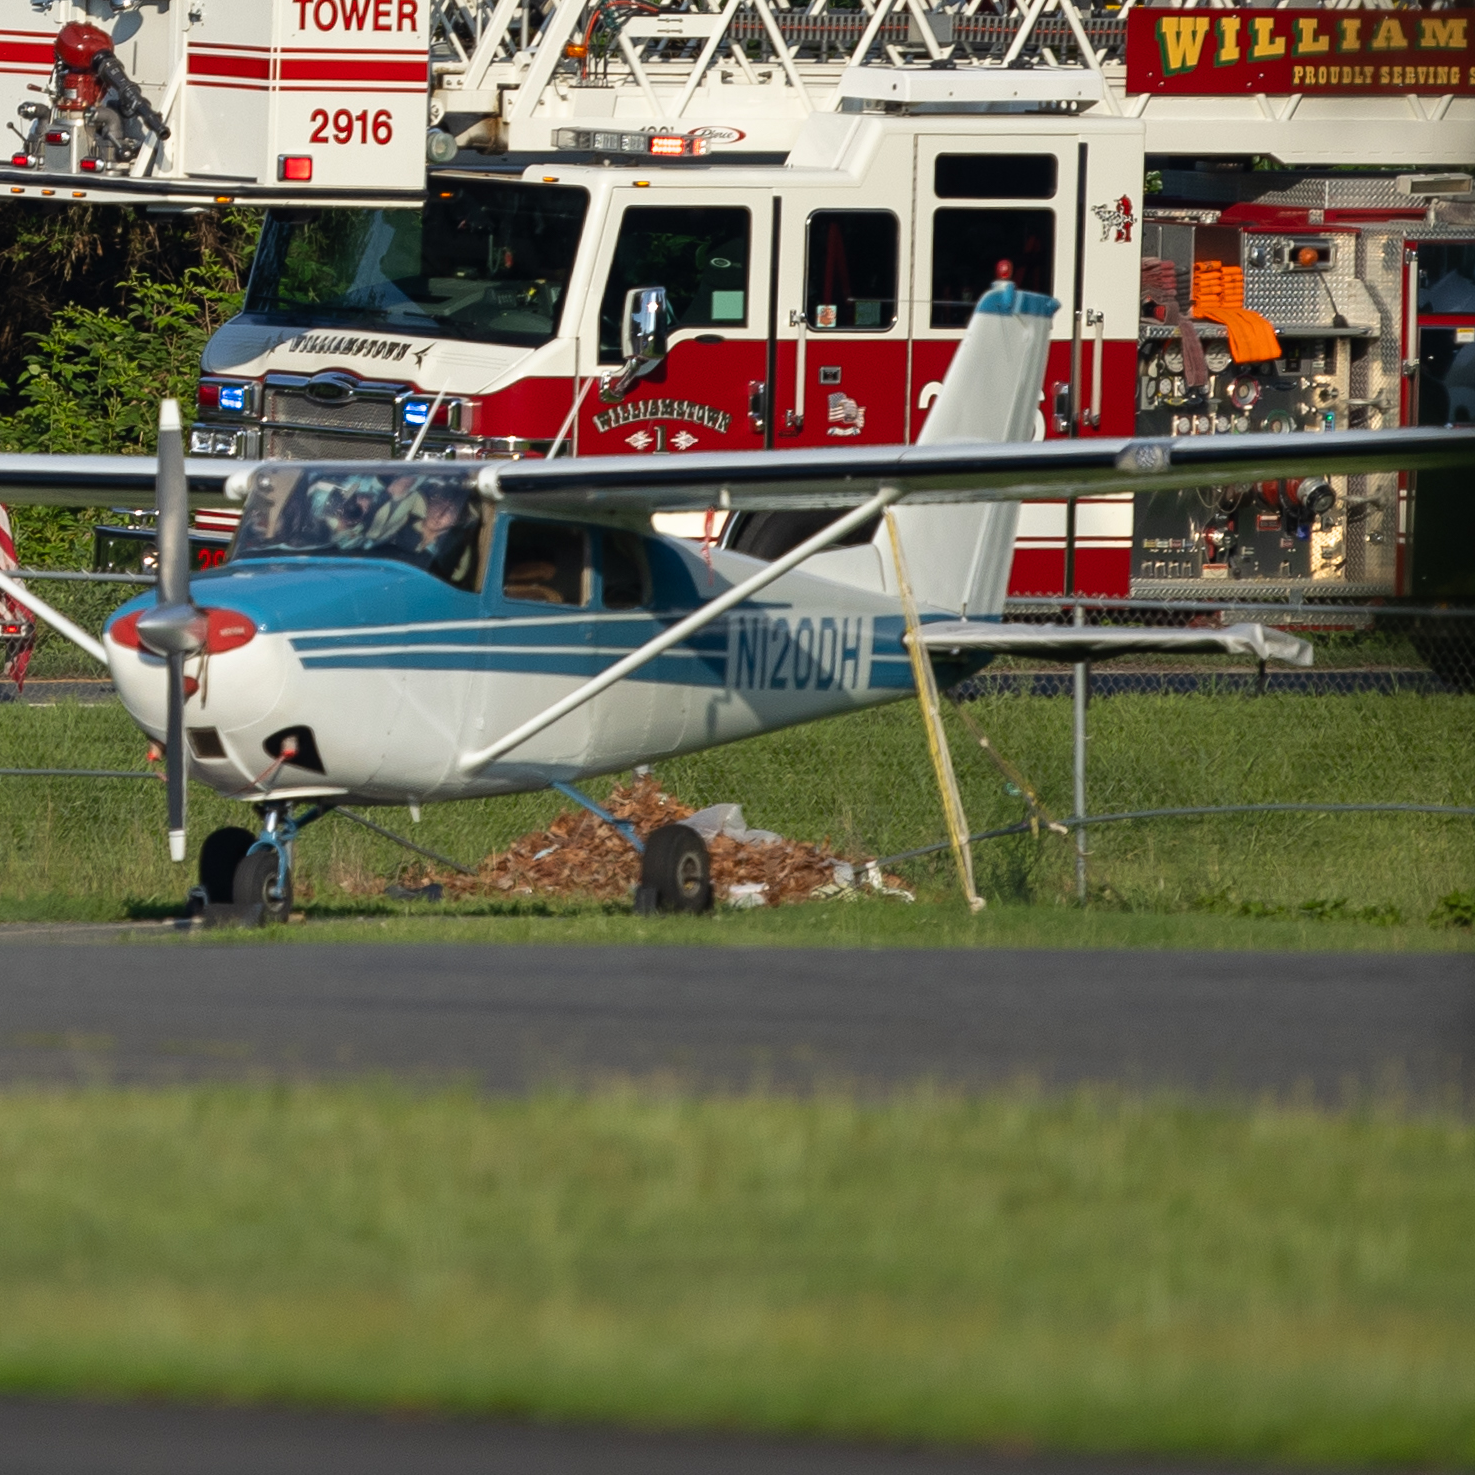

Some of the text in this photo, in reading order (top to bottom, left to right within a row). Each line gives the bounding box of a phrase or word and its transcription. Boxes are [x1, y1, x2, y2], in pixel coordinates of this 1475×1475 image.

[1155, 16, 1468, 77] WILLIAM
[1292, 65, 1373, 86] PROUDLY
[1380, 65, 1461, 86] SERVING
[309, 108, 393, 146] 2916
[592, 398, 732, 434] WILLIAMSTOWN
